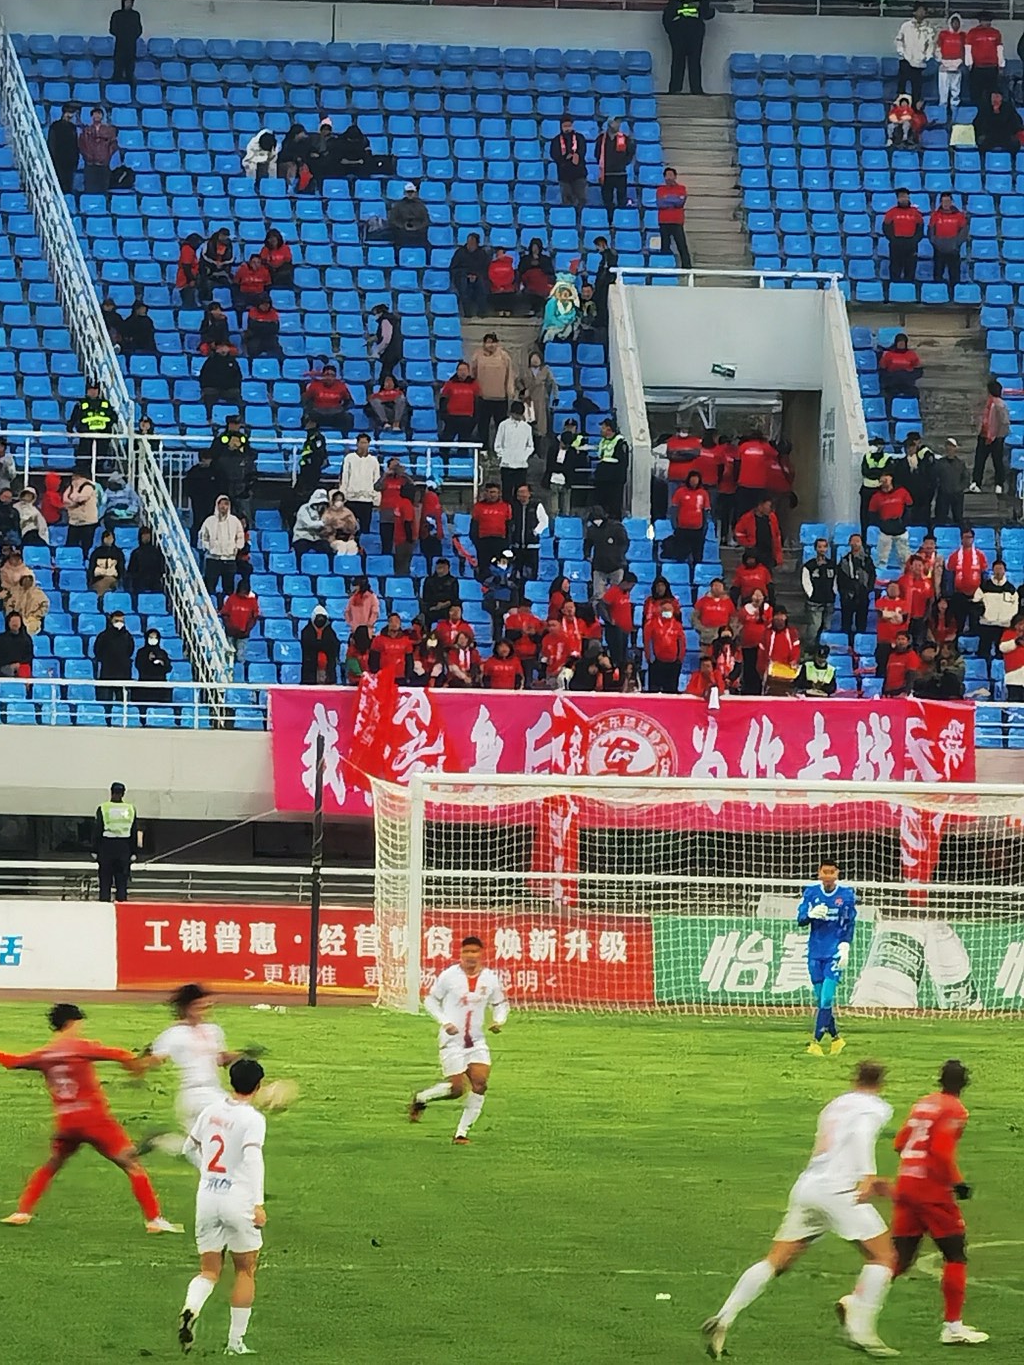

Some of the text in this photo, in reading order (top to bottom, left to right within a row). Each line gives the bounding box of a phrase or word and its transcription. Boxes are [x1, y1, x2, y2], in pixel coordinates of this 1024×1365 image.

[493, 927, 629, 964] 焕新升级
[206, 1134, 227, 1173] 2
